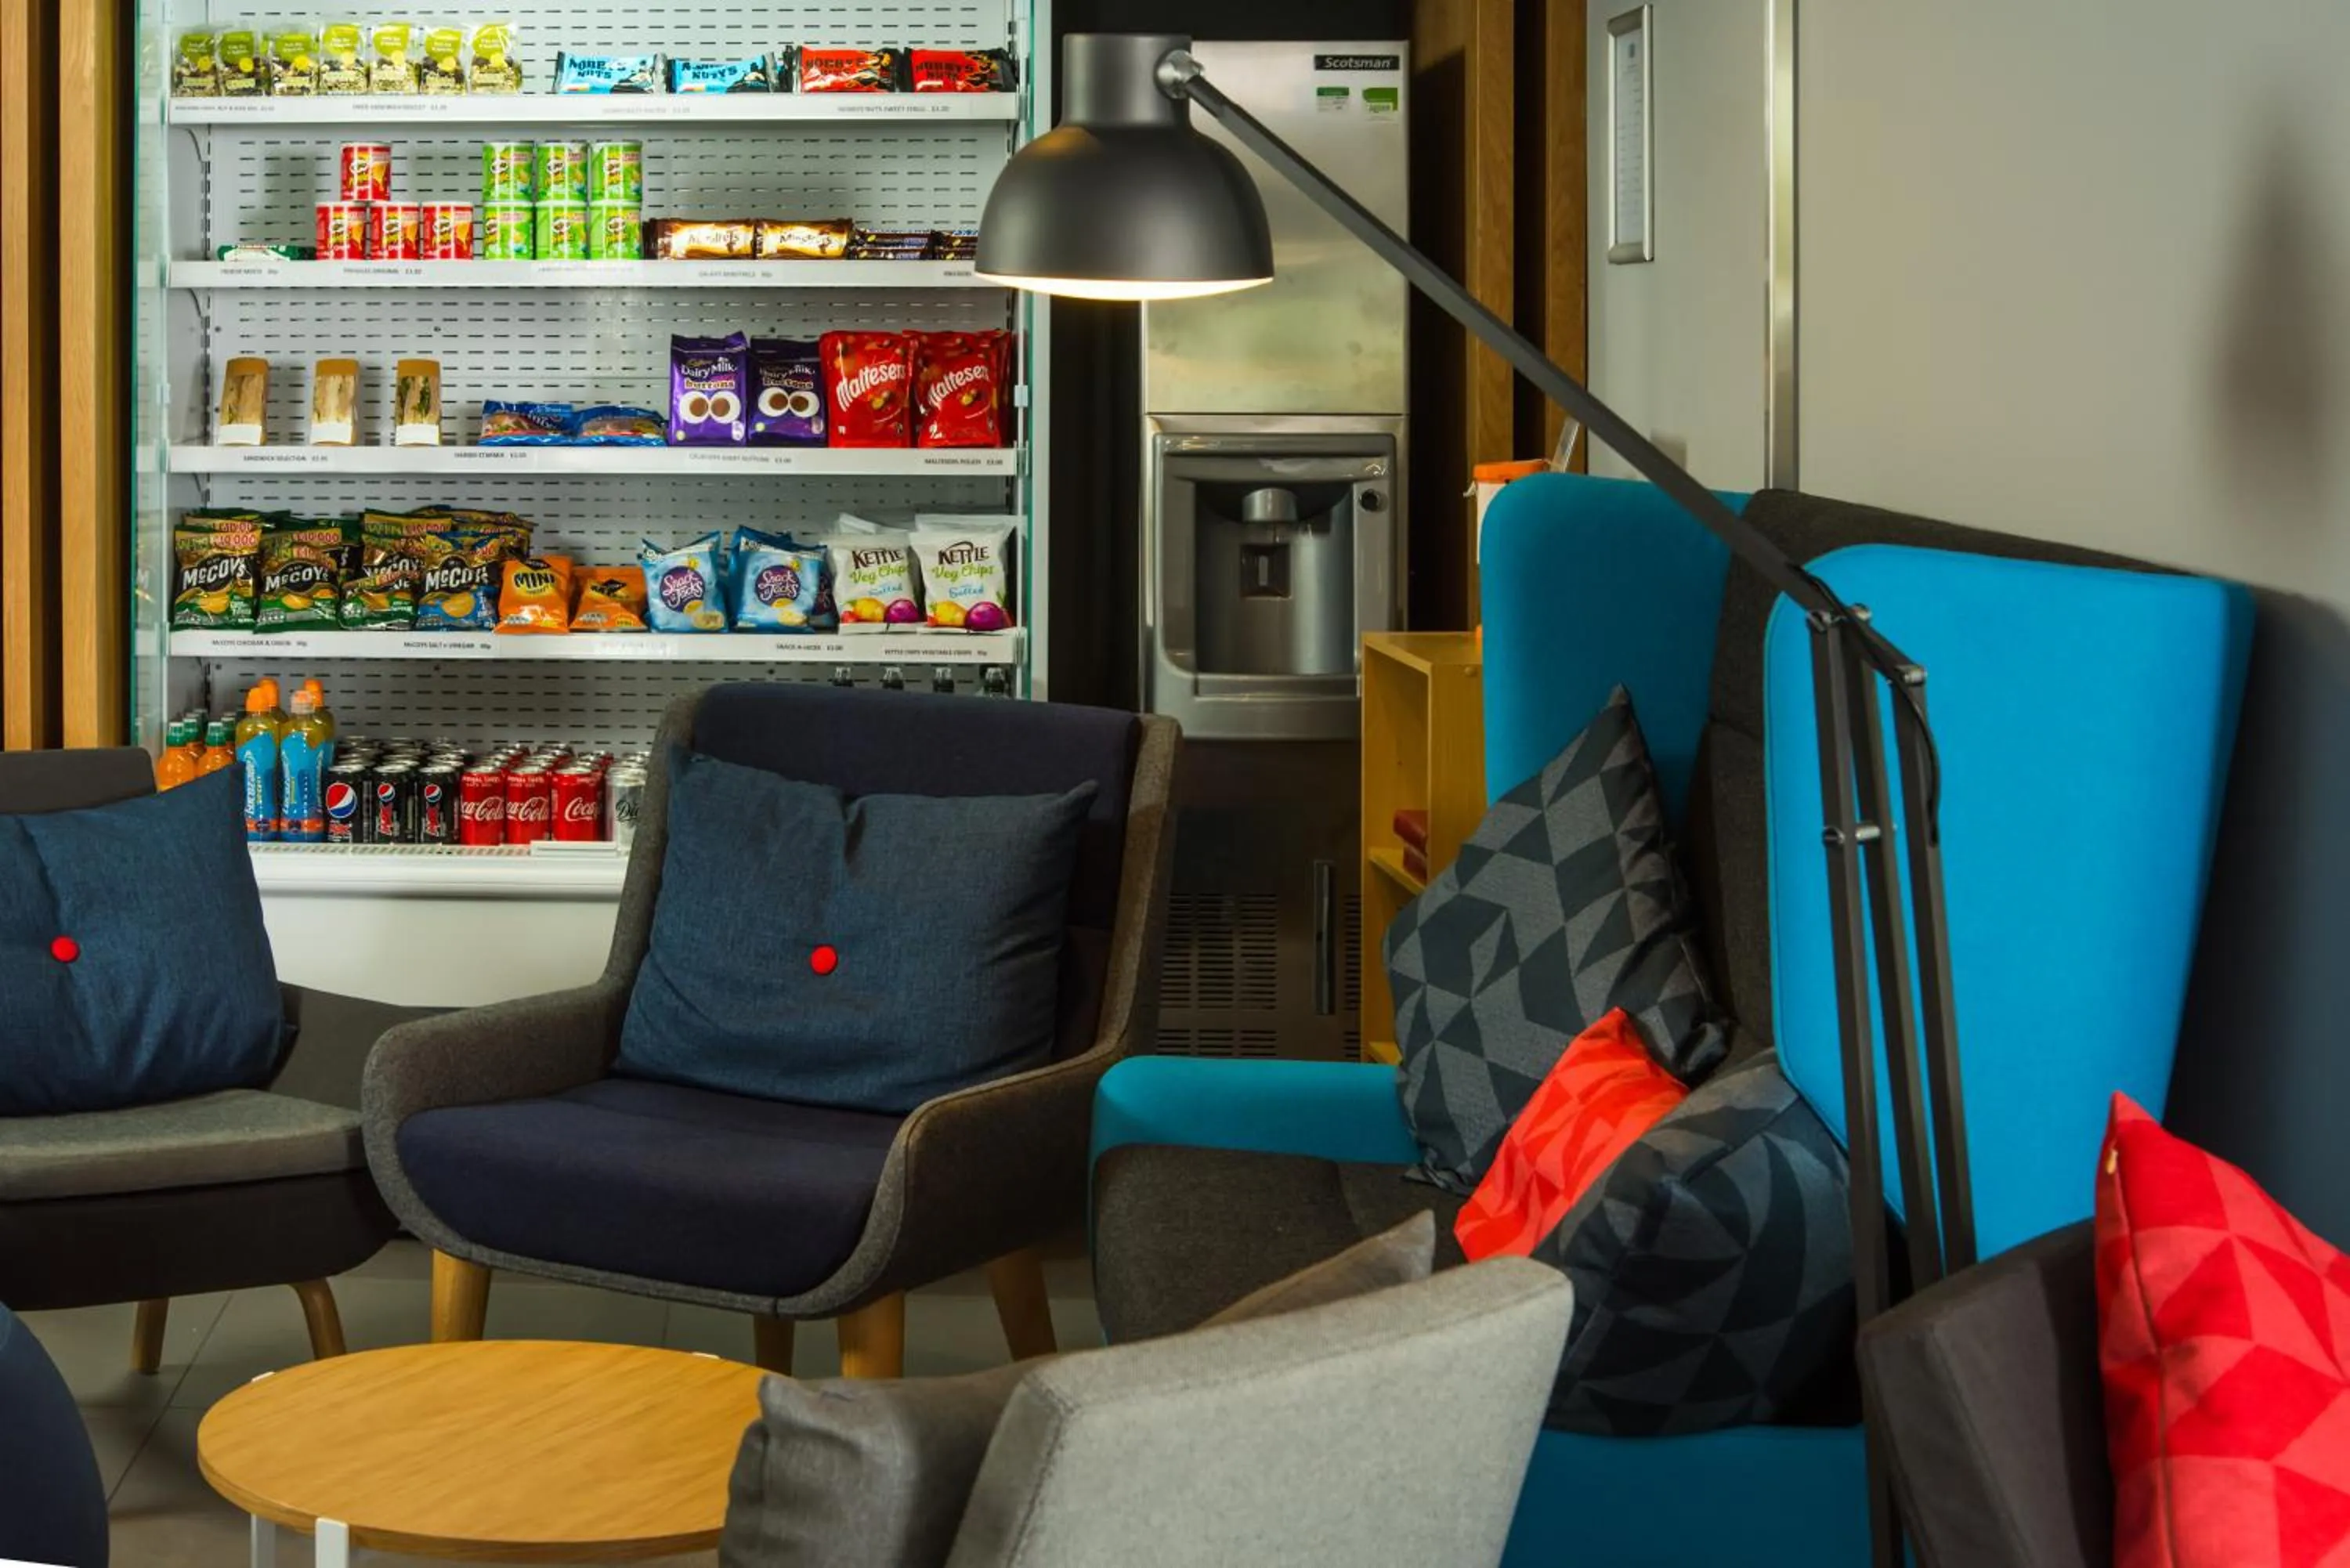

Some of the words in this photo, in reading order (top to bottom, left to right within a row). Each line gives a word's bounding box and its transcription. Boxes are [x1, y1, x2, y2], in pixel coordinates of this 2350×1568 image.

[1325, 57, 1391, 68] Scotsman
[681, 363, 710, 379] Dairy
[710, 360, 734, 374] Milk
[851, 548, 904, 569] KETTLE
[938, 541, 990, 565] KETTLE
[514, 573, 556, 588] MINI
[663, 569, 700, 595] Snack
[757, 570, 797, 590] Snack
[848, 569, 877, 584] Veg
[931, 565, 959, 582] Veg
[960, 562, 995, 577] Chips
[667, 582, 703, 609] Jacks
[760, 582, 800, 602] Jacks
